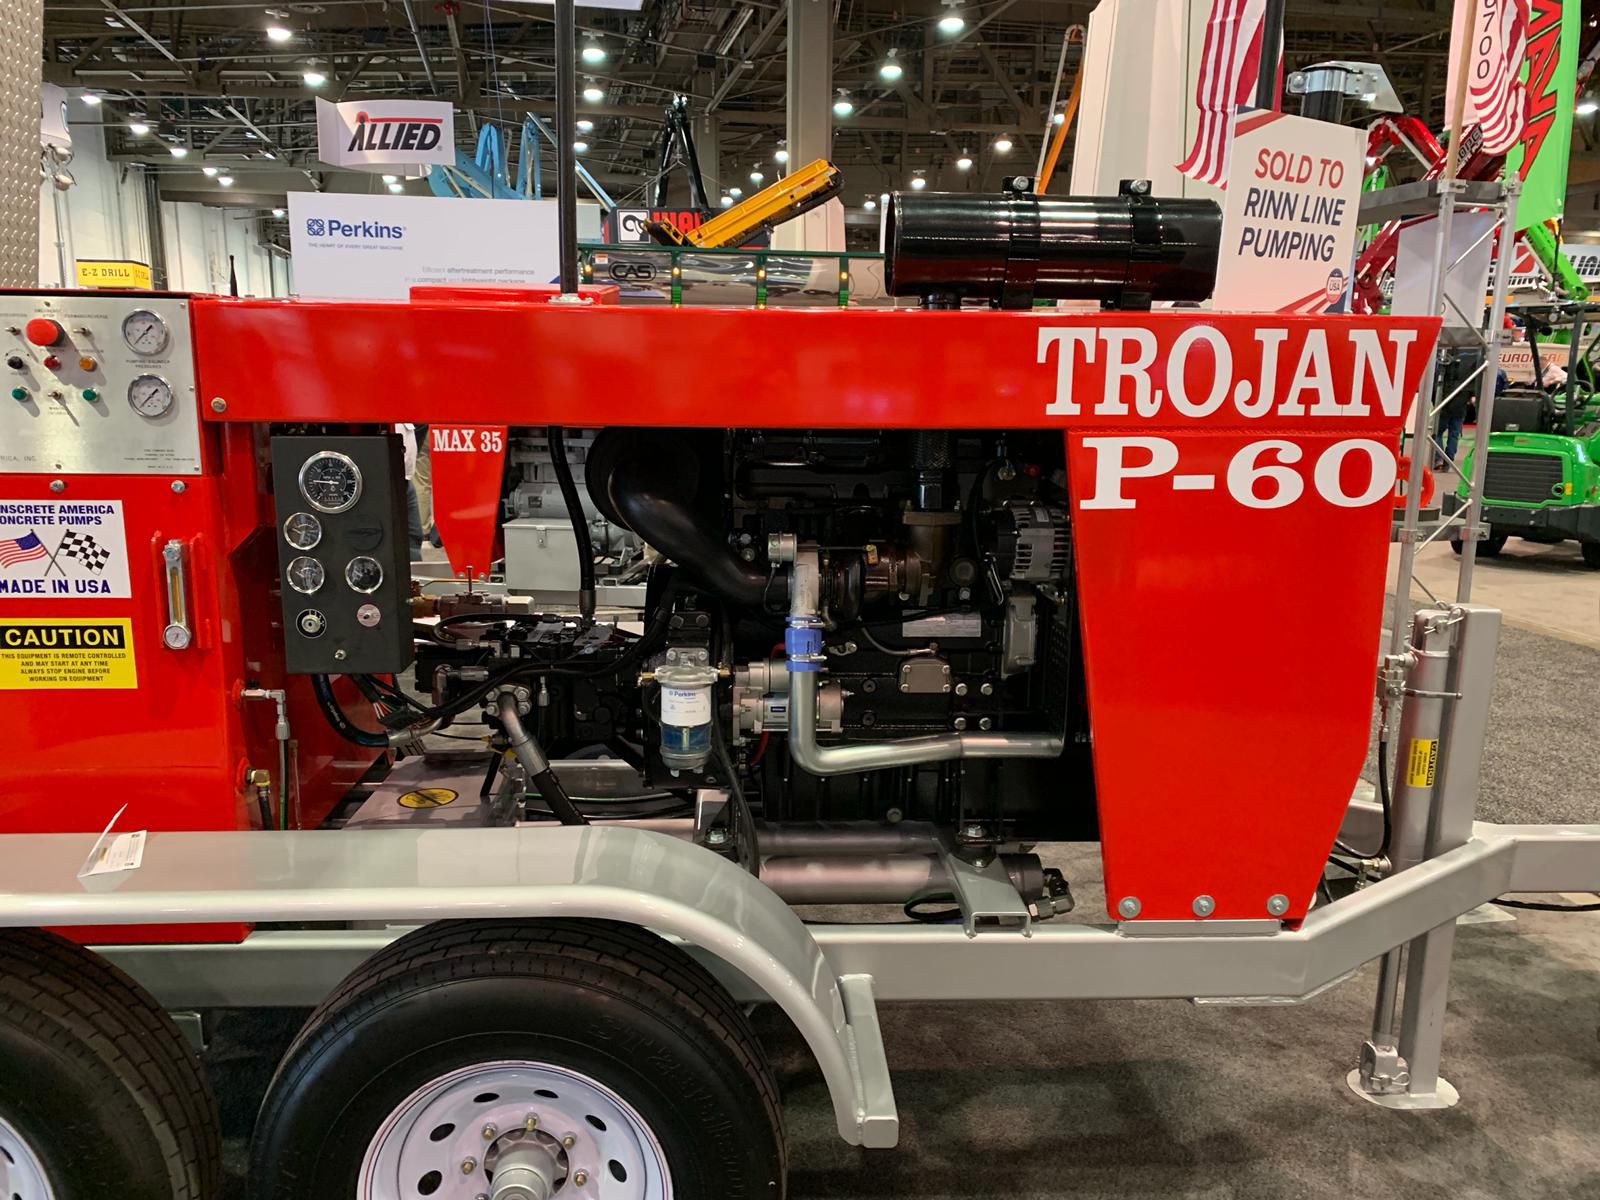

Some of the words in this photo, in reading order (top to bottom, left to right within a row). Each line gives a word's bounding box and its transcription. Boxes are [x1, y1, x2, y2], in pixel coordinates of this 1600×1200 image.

[347, 118, 441, 152] ALLIED
[1254, 148, 1313, 184] SOLD
[1318, 158, 1344, 189] TO
[1243, 187, 1299, 221] RINN
[1300, 194, 1346, 226] LINE
[328, 219, 403, 239] Perkins
[1238, 227, 1336, 262] PUMPING
[81, 268, 98, 276] E-Z
[101, 268, 130, 277] DRILL
[612, 265, 651, 279] CAS
[1037, 325, 1418, 418] TROJAN
[432, 429, 477, 452] MAX
[480, 431, 503, 453] 35
[1080, 437, 1397, 509] P-60
[58, 505, 115, 514] AMERICA
[59, 516, 102, 525] PUMPS
[0, 579, 46, 593] MADE
[52, 579, 69, 593] IN
[75, 579, 111, 593] USA
[5, 628, 119, 646] CAUTION
[1426, 741, 1437, 786] CAUTION
